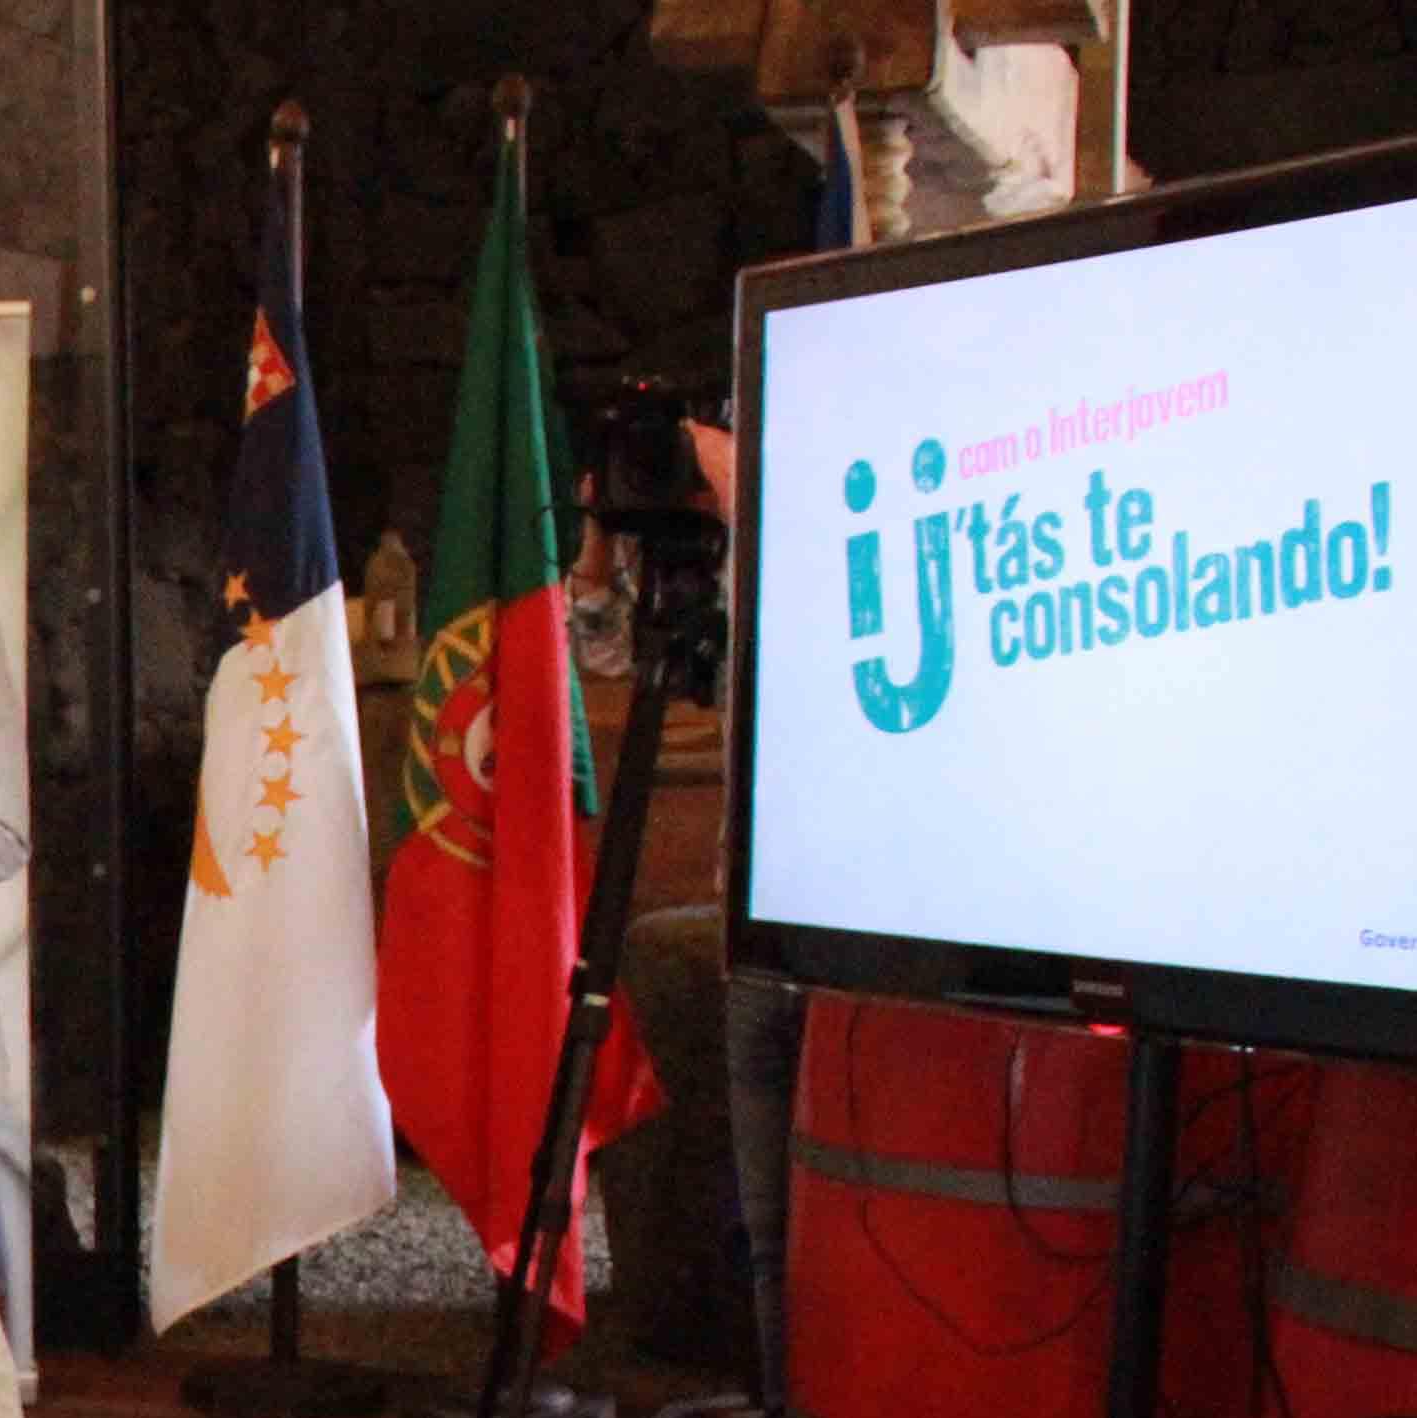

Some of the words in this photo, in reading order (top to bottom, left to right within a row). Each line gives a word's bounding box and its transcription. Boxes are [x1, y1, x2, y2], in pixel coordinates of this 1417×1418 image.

[958, 433, 1018, 480] com
[1025, 425, 1042, 463] o
[1049, 369, 1230, 456] Interjovem
[1085, 469, 1154, 567] te
[990, 481, 1393, 668] consolando!
